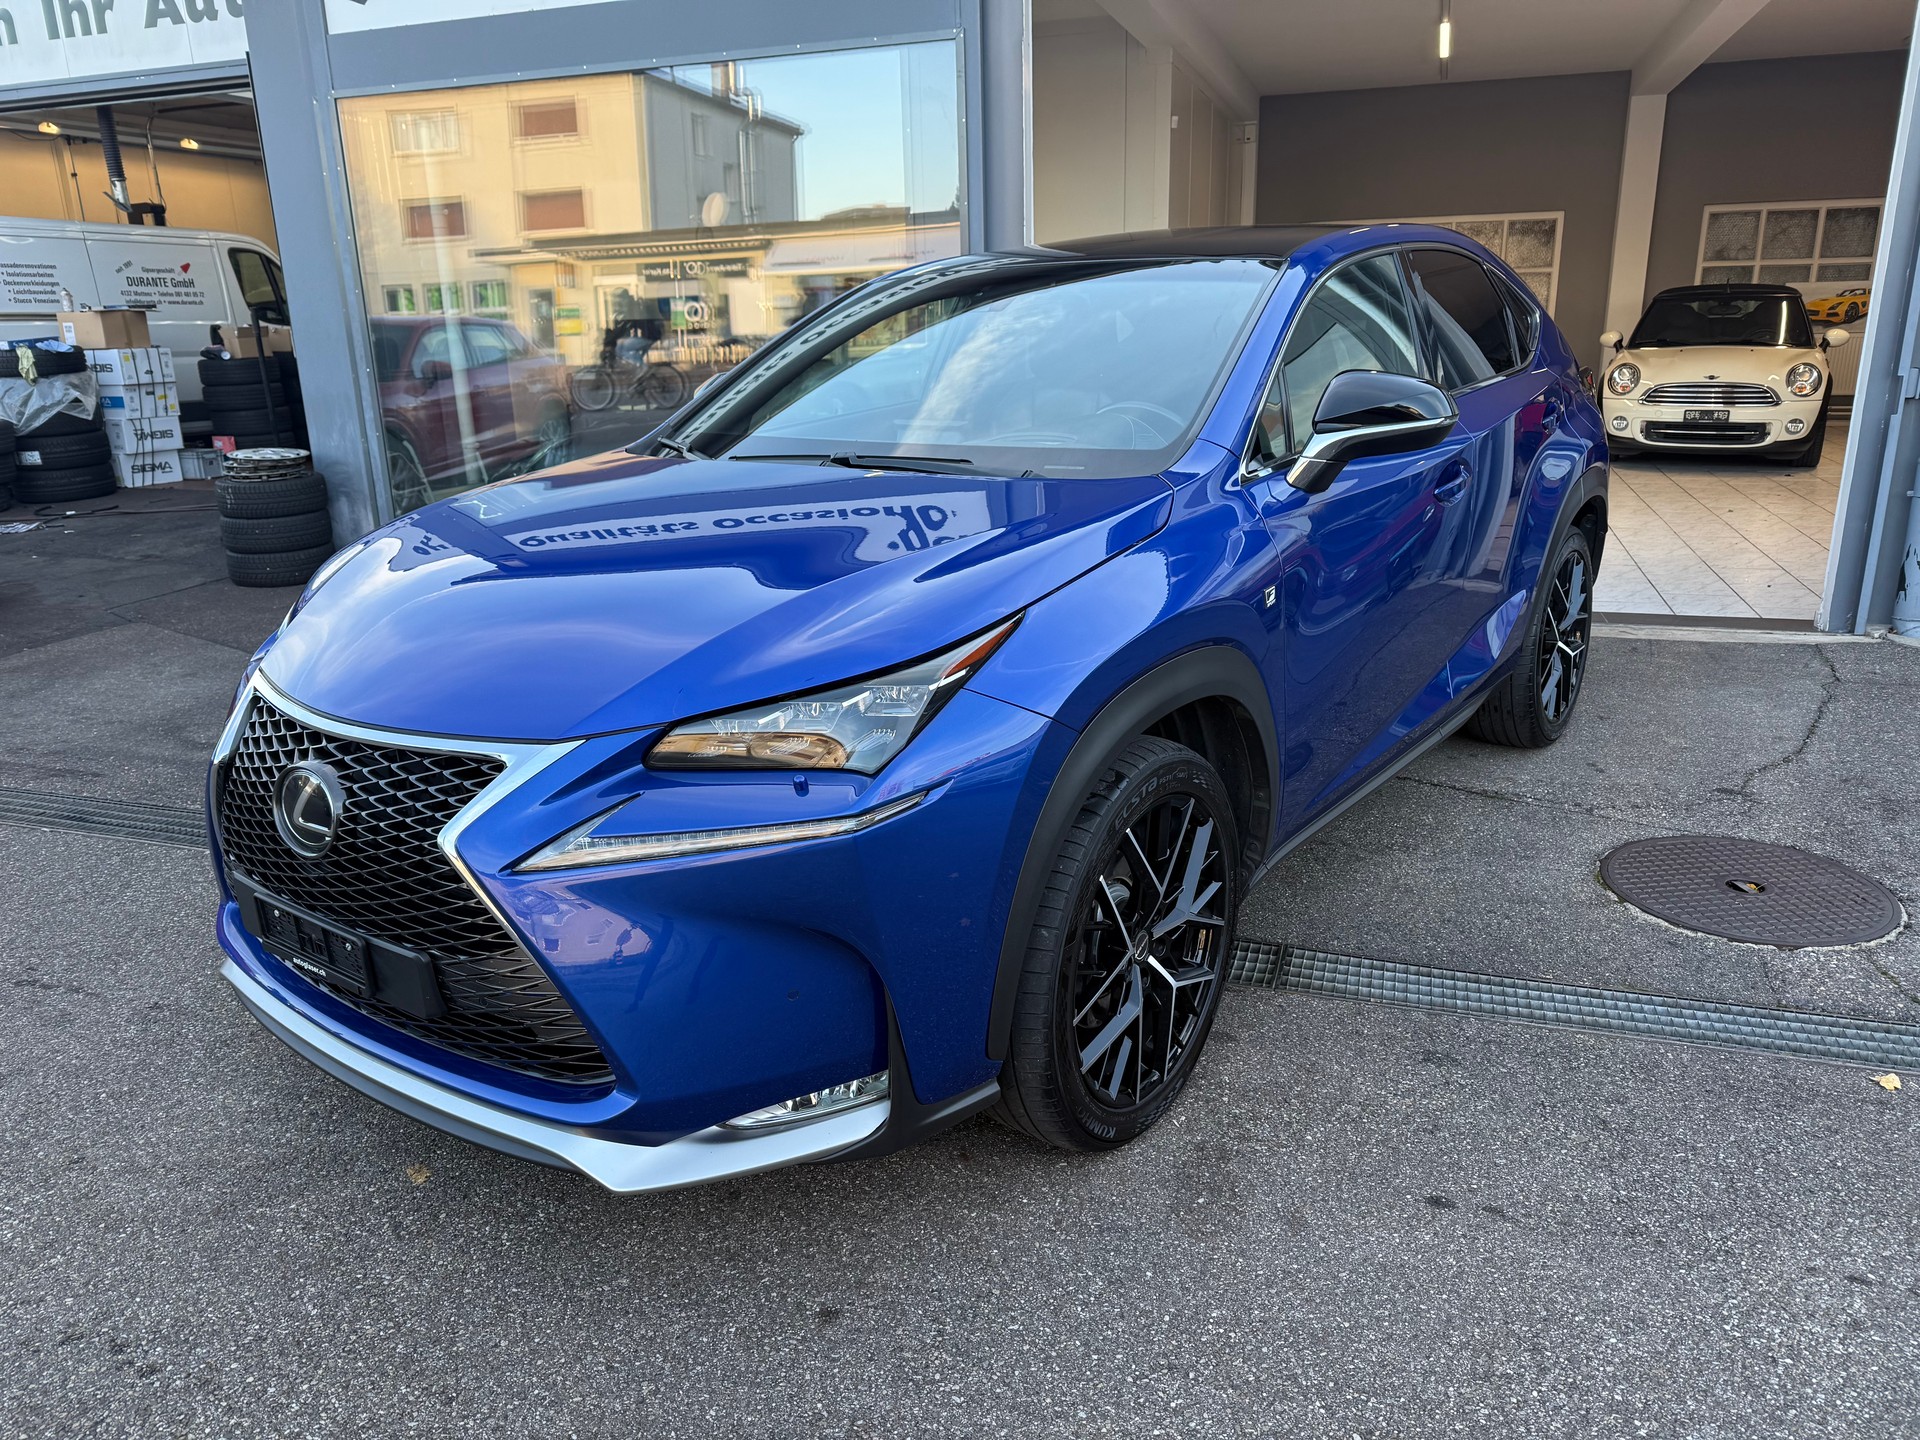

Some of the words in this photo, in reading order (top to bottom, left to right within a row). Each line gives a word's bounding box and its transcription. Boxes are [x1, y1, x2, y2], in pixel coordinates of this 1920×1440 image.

[41, 0, 115, 40] Ihr
[6, 270, 54, 278] Isolationsarbeiten
[3, 279, 60, 288] Deckenverkleidungen
[126, 276, 169, 288] DURANTE
[170, 277, 195, 289] GmbH
[133, 429, 174, 441] SIGMA
[131, 461, 173, 475] SIGMA
[1078, 1107, 1116, 1138] KUMHO
